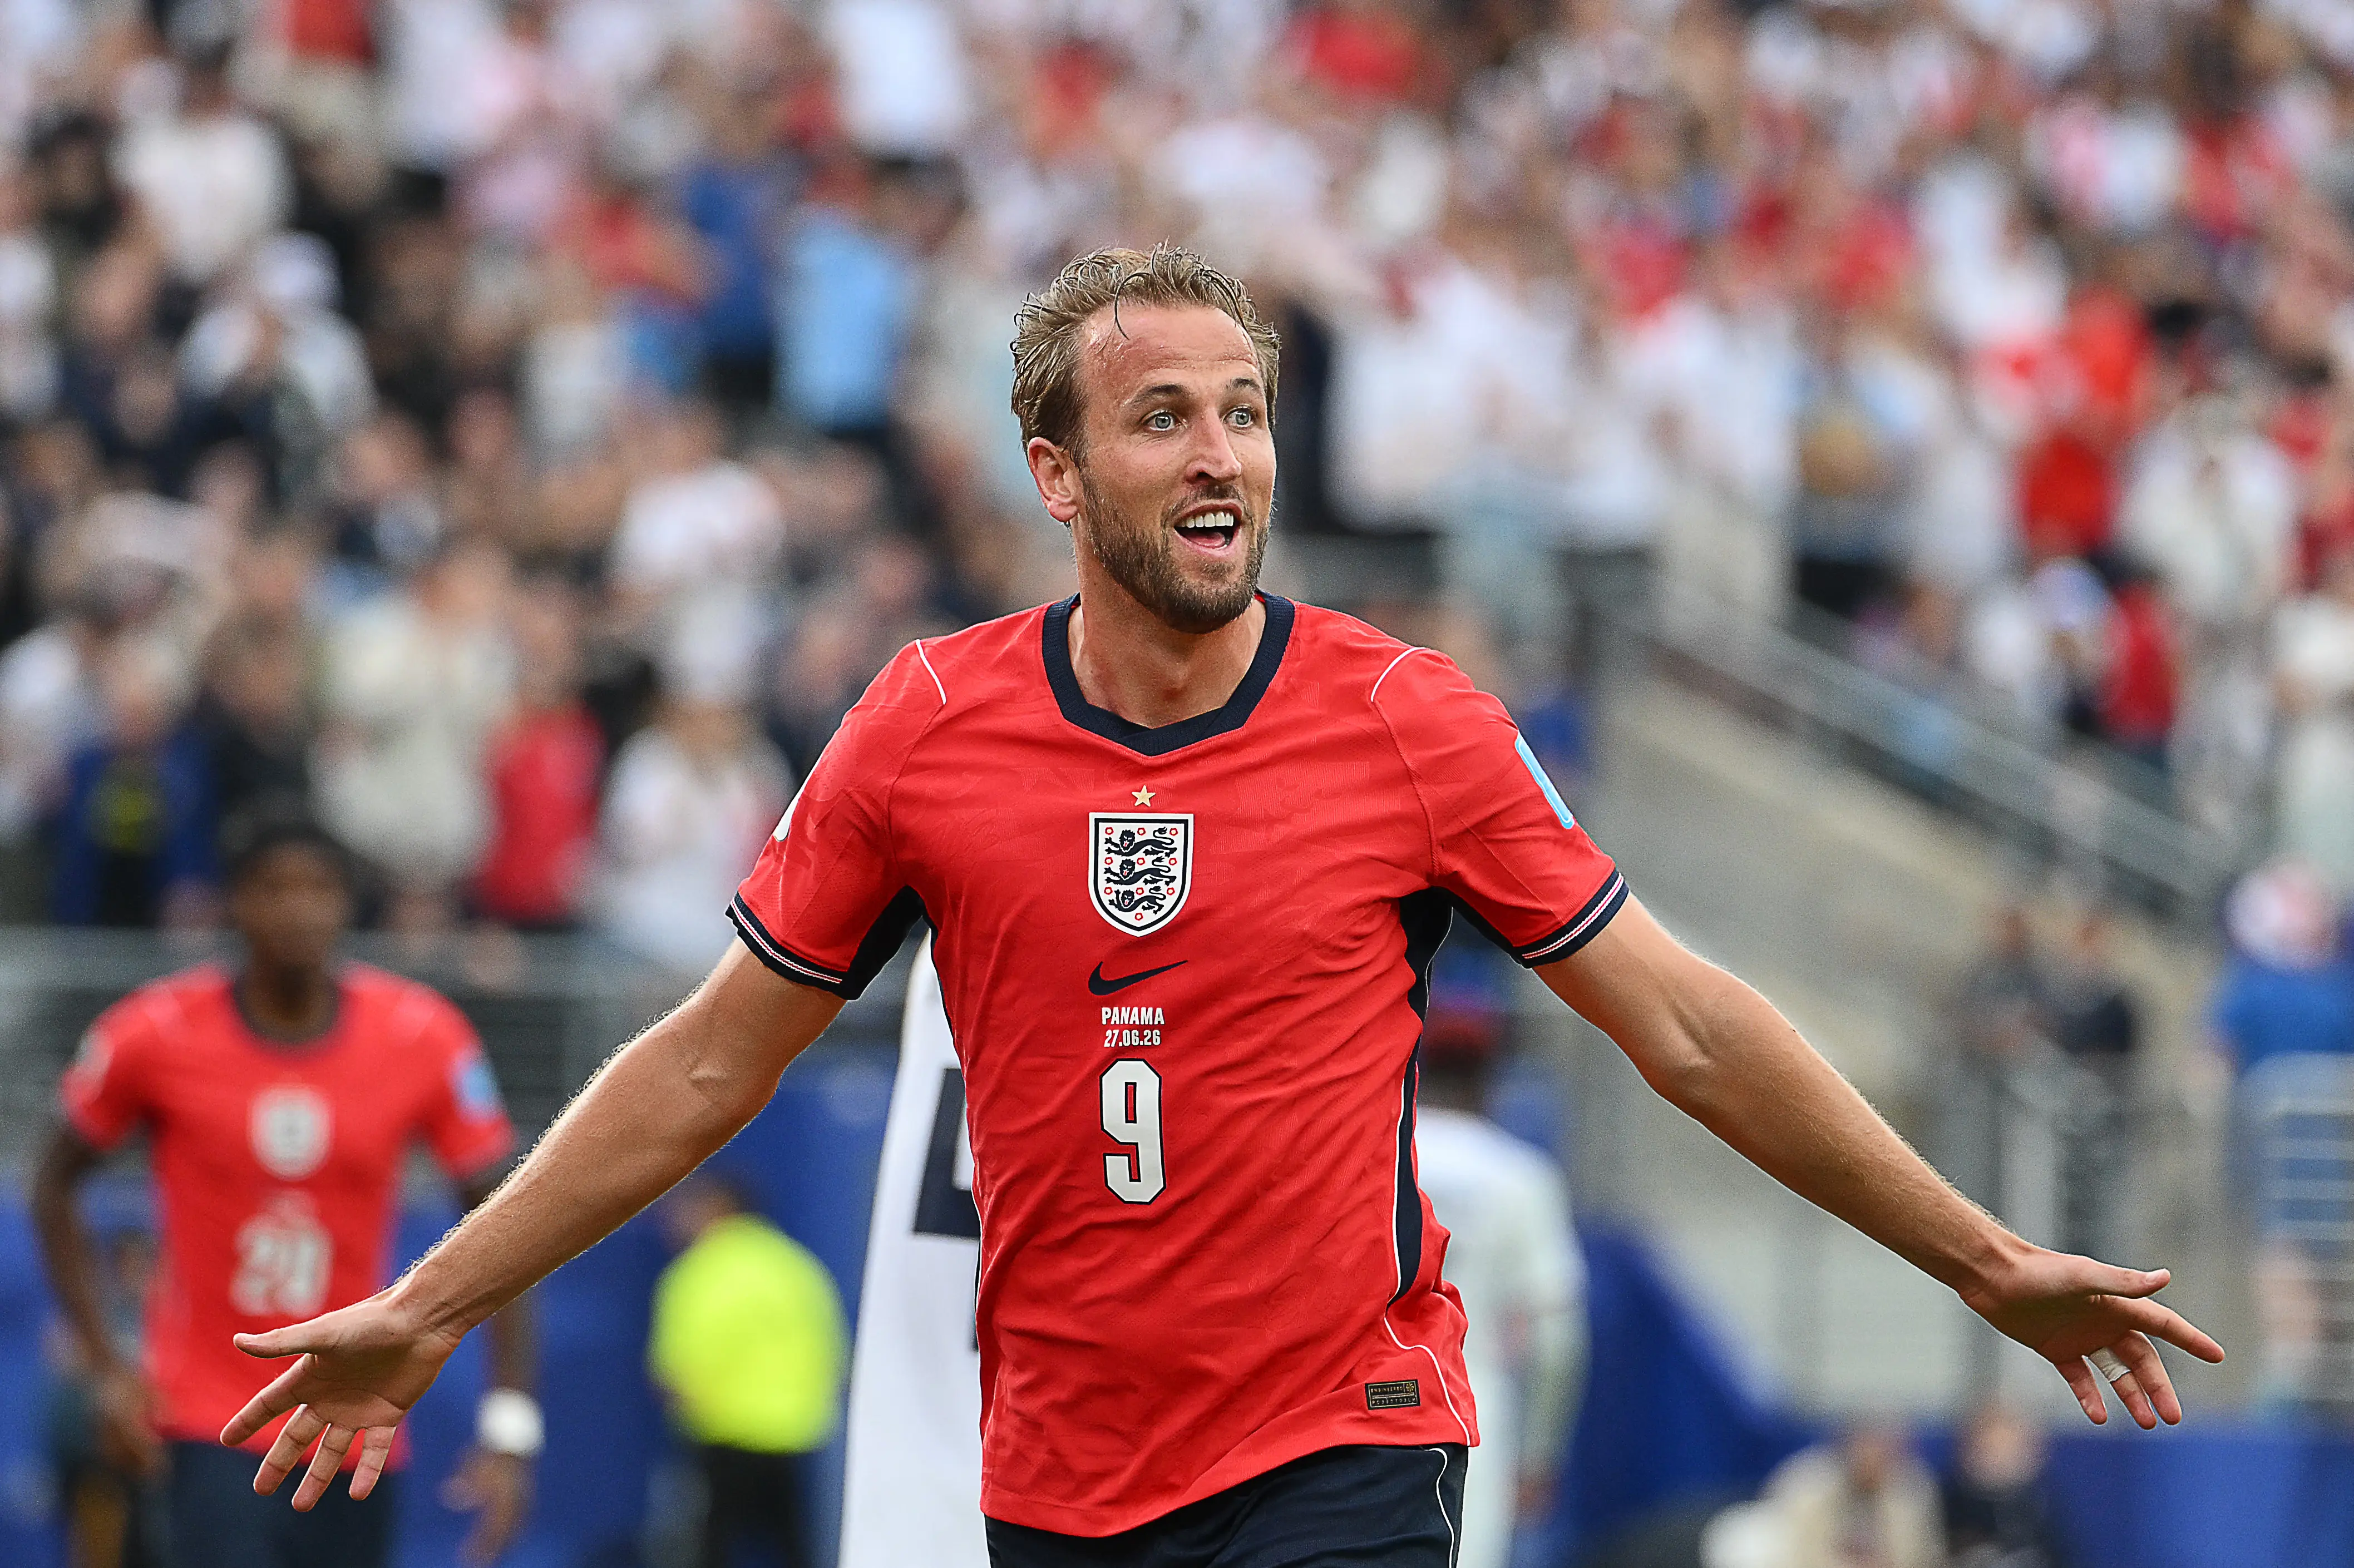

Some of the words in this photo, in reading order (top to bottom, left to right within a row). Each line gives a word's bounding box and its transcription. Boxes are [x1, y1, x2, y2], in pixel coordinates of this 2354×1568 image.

[1102, 1006, 1165, 1025] PANAMA
[1103, 1029, 1161, 1047] 27.06.26
[1099, 1058, 1166, 1205] 9
